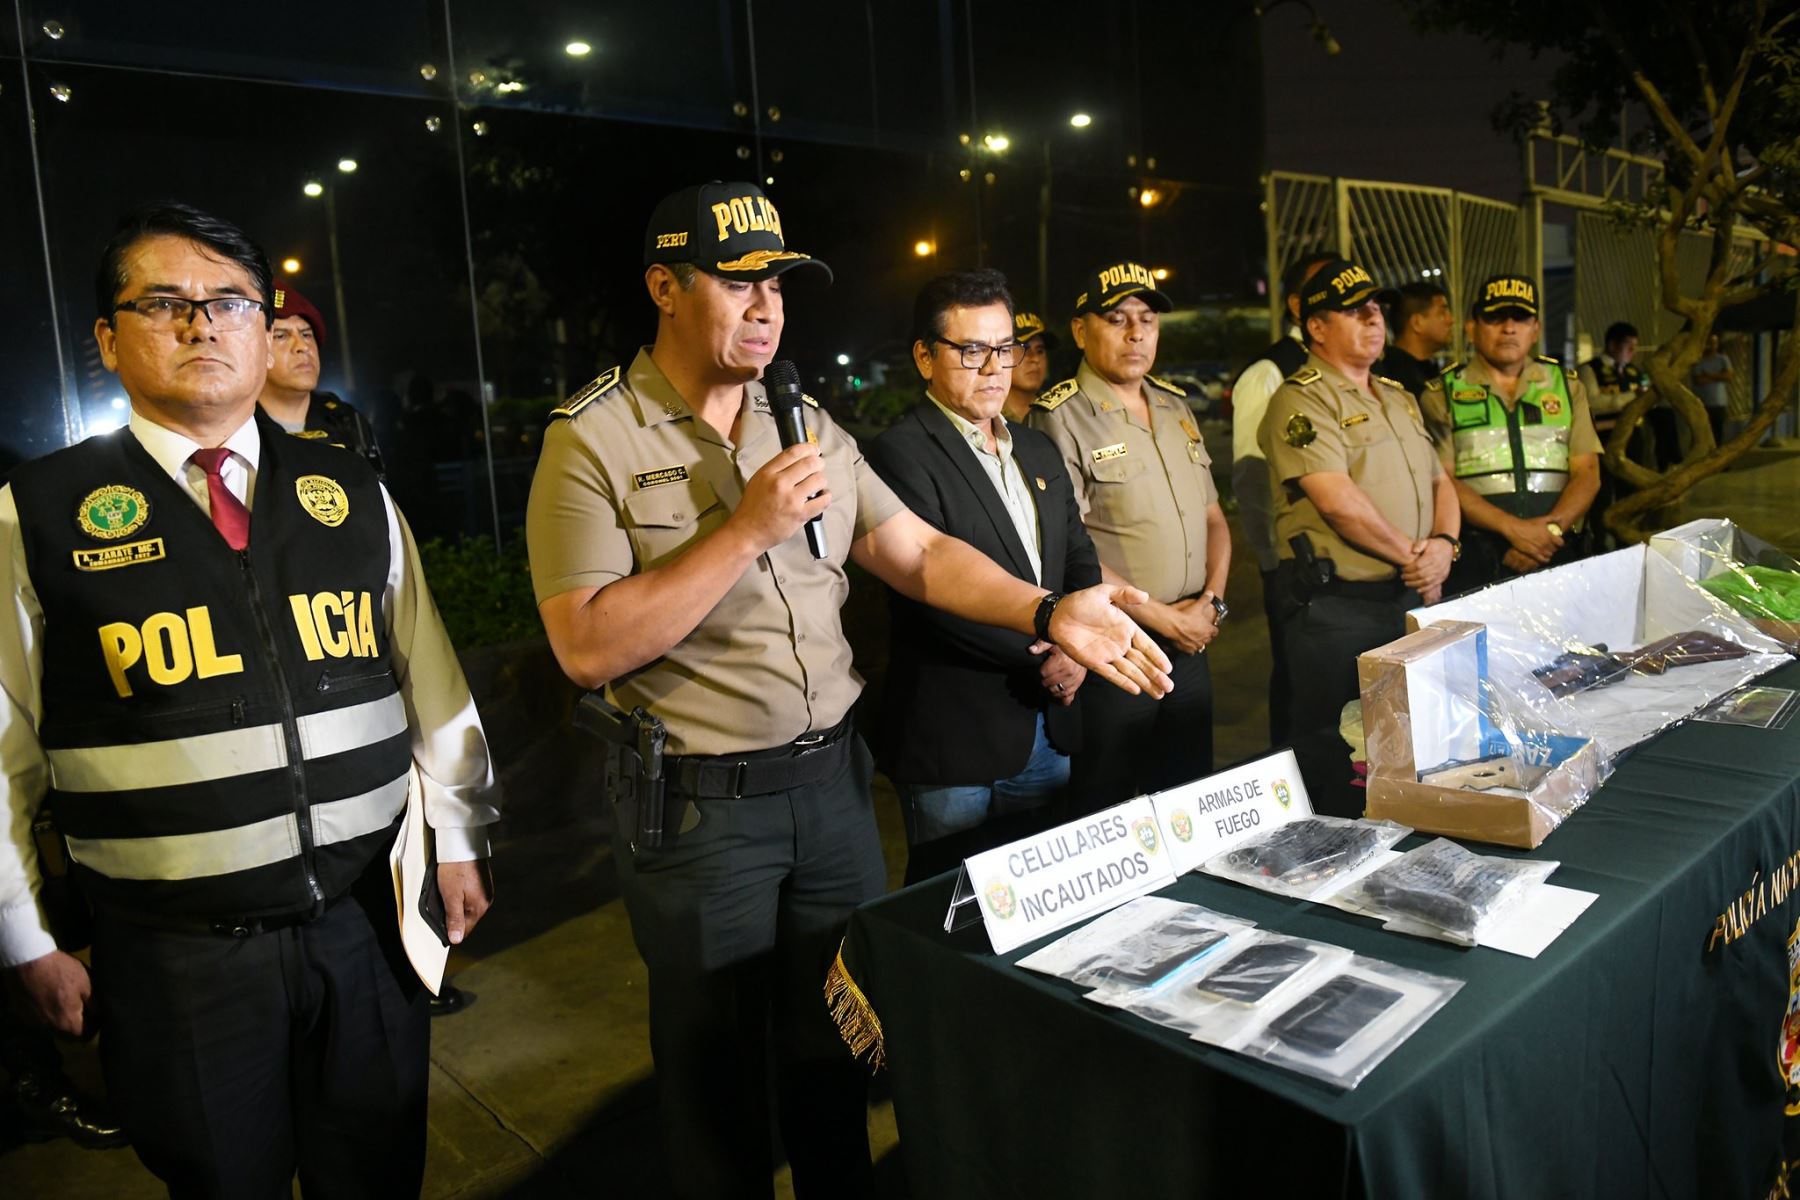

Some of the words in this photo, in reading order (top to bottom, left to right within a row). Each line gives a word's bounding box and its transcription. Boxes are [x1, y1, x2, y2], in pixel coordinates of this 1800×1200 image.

[656, 231, 688, 249] PERU
[1098, 261, 1156, 294] POLICIA
[1484, 278, 1535, 304] POLICIA
[1198, 785, 1244, 816] ARMAS
[1243, 778, 1264, 800] DE
[1215, 808, 1261, 839] FUEGO
[1008, 814, 1128, 878] CELULARES
[1019, 852, 1149, 923] INCAUTADOS
[1708, 870, 1767, 953] POLICÍA
